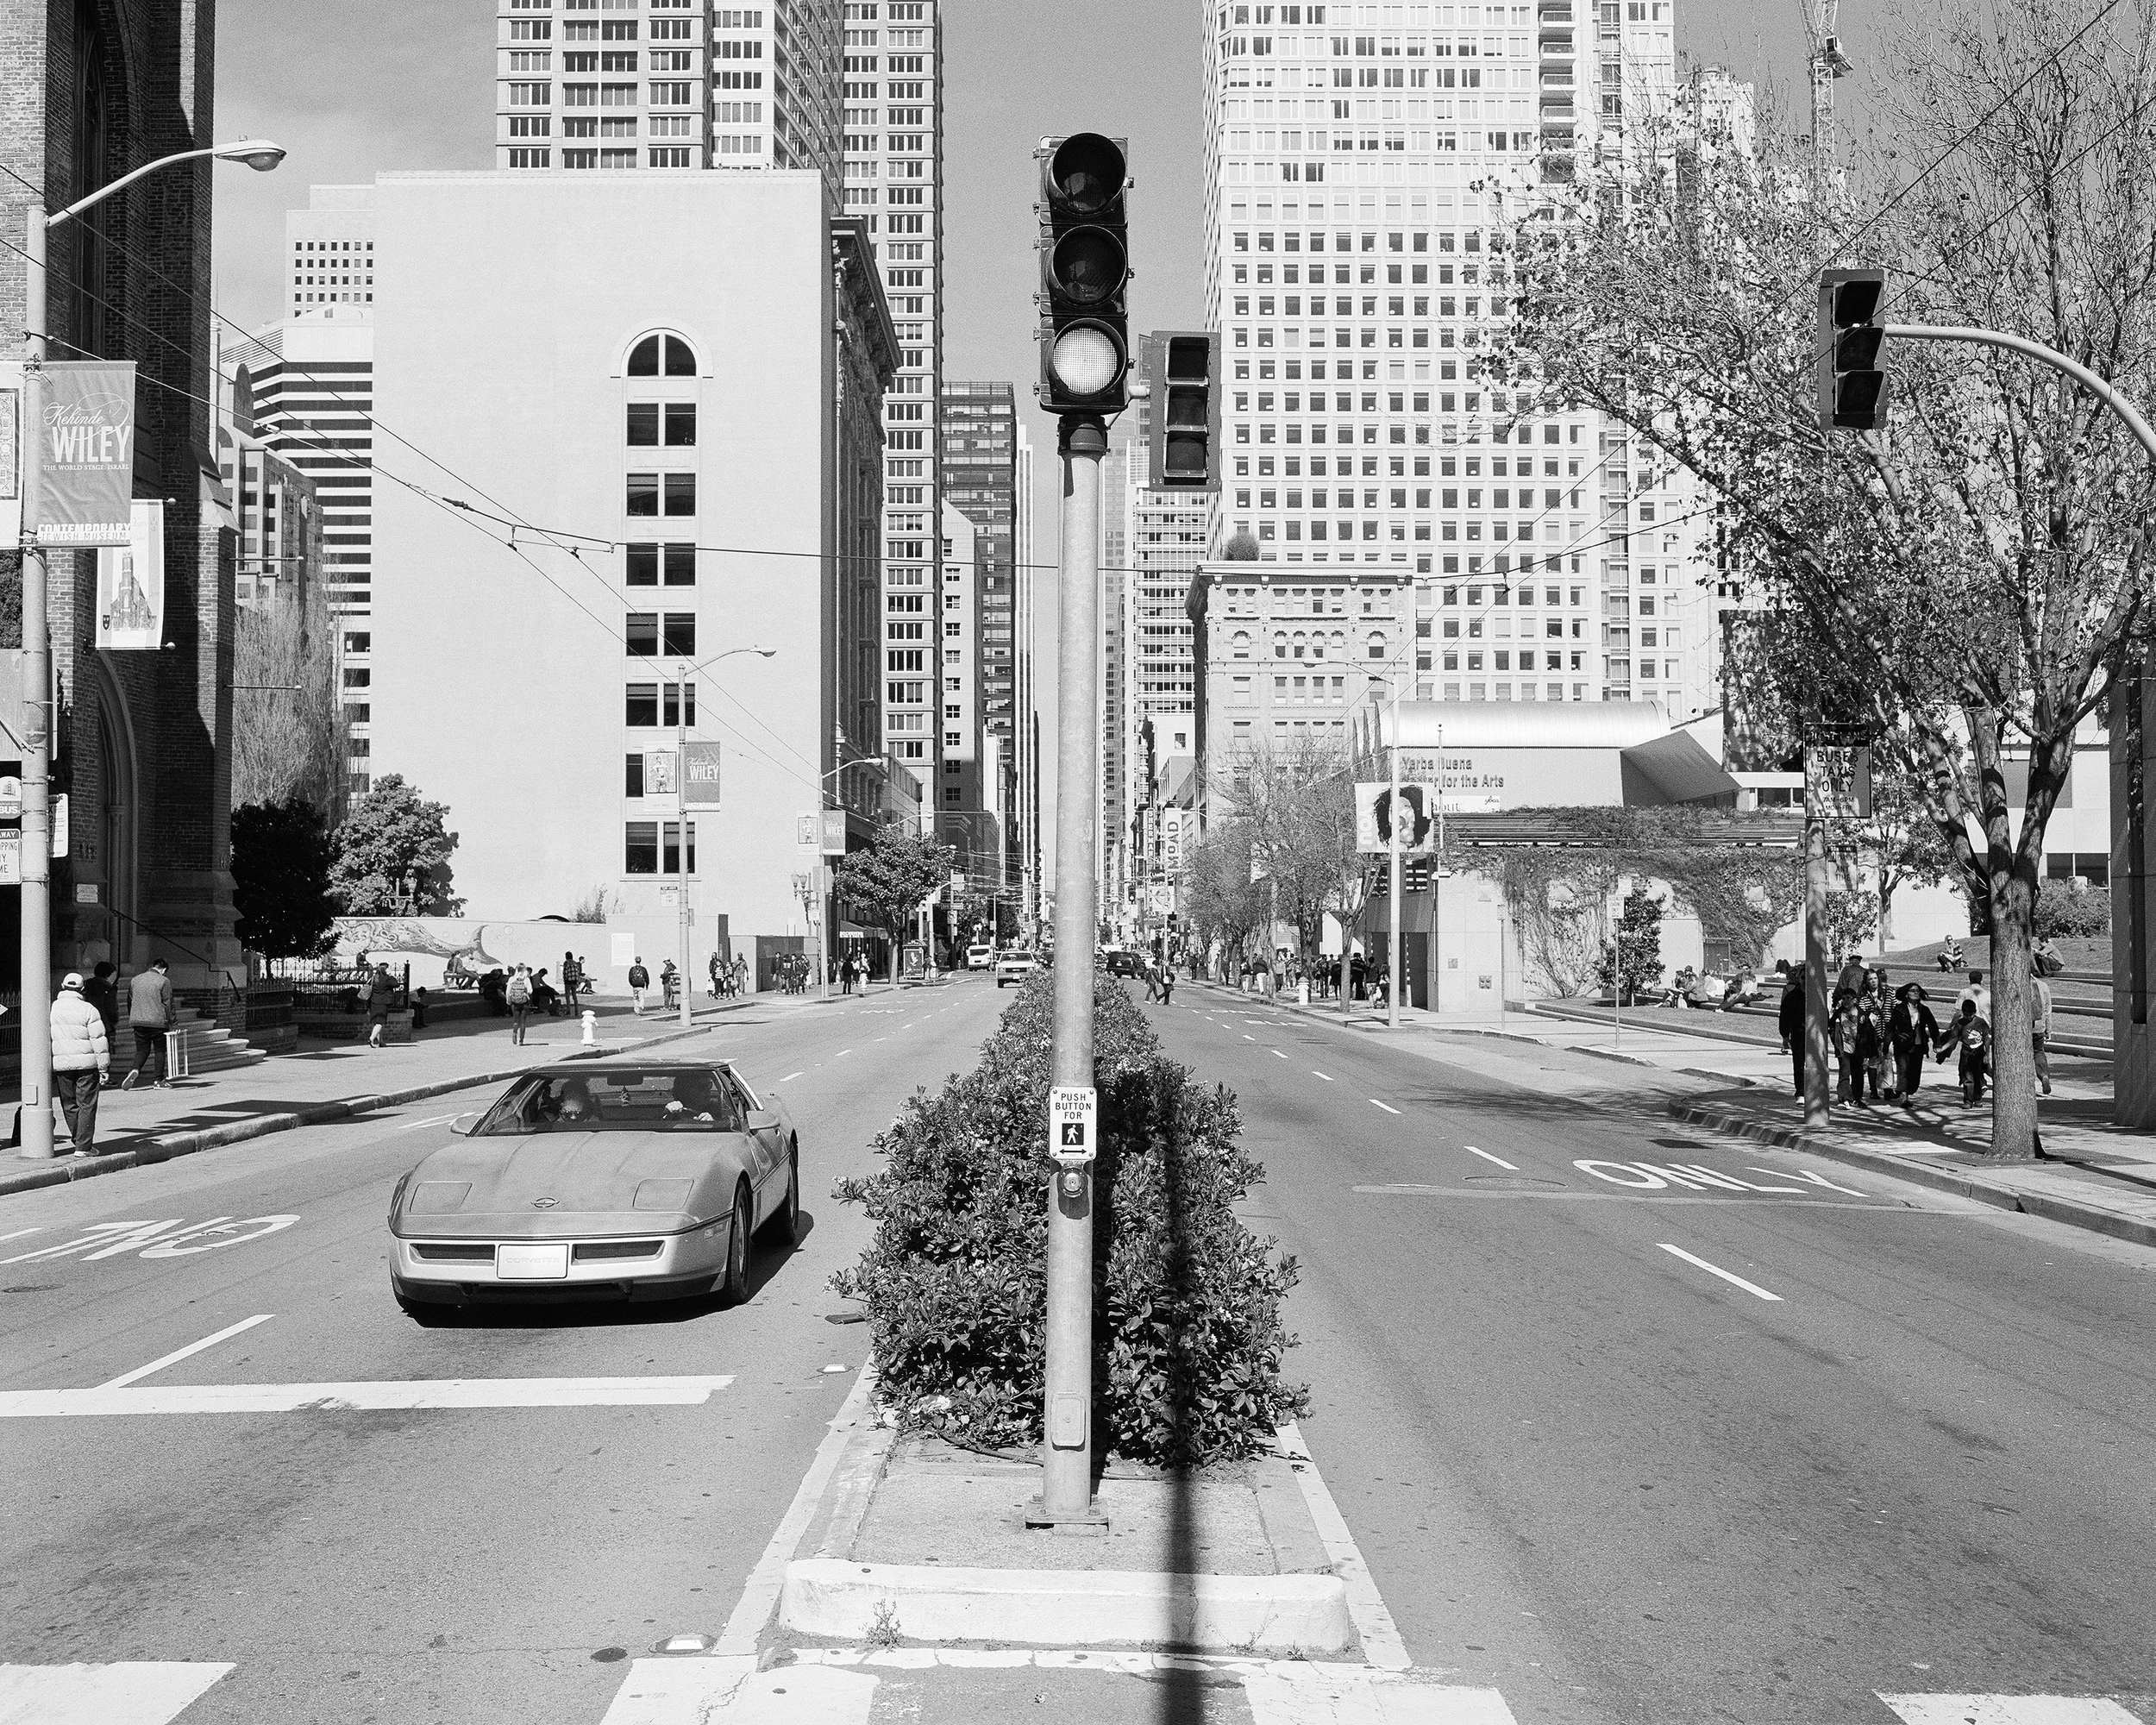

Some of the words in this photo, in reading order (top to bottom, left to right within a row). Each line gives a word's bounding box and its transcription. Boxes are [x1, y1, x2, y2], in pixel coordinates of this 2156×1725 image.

[43, 402, 104, 425] Kehinde
[52, 426, 131, 463] WILEY
[37, 523, 131, 533] CONTEMPORARY
[40, 532, 78, 541] JEWISH
[84, 531, 127, 541] MUSEUM
[1401, 756, 1434, 770] Yerba
[1816, 750, 1858, 762] BUSES
[690, 766, 719, 781] WILEY
[1820, 765, 1856, 777] TAXIS
[1442, 774, 1458, 788] for
[1460, 774, 1479, 788] the
[1481, 774, 1505, 788] Arts
[1821, 780, 1855, 793] ONLY
[0, 806, 18, 814] BUS
[0, 842, 18, 851] PPING
[1167, 821, 1179, 869] MOAD
[1572, 1159, 1871, 1198] ONLY
[0, 1214, 302, 1264] ONL
